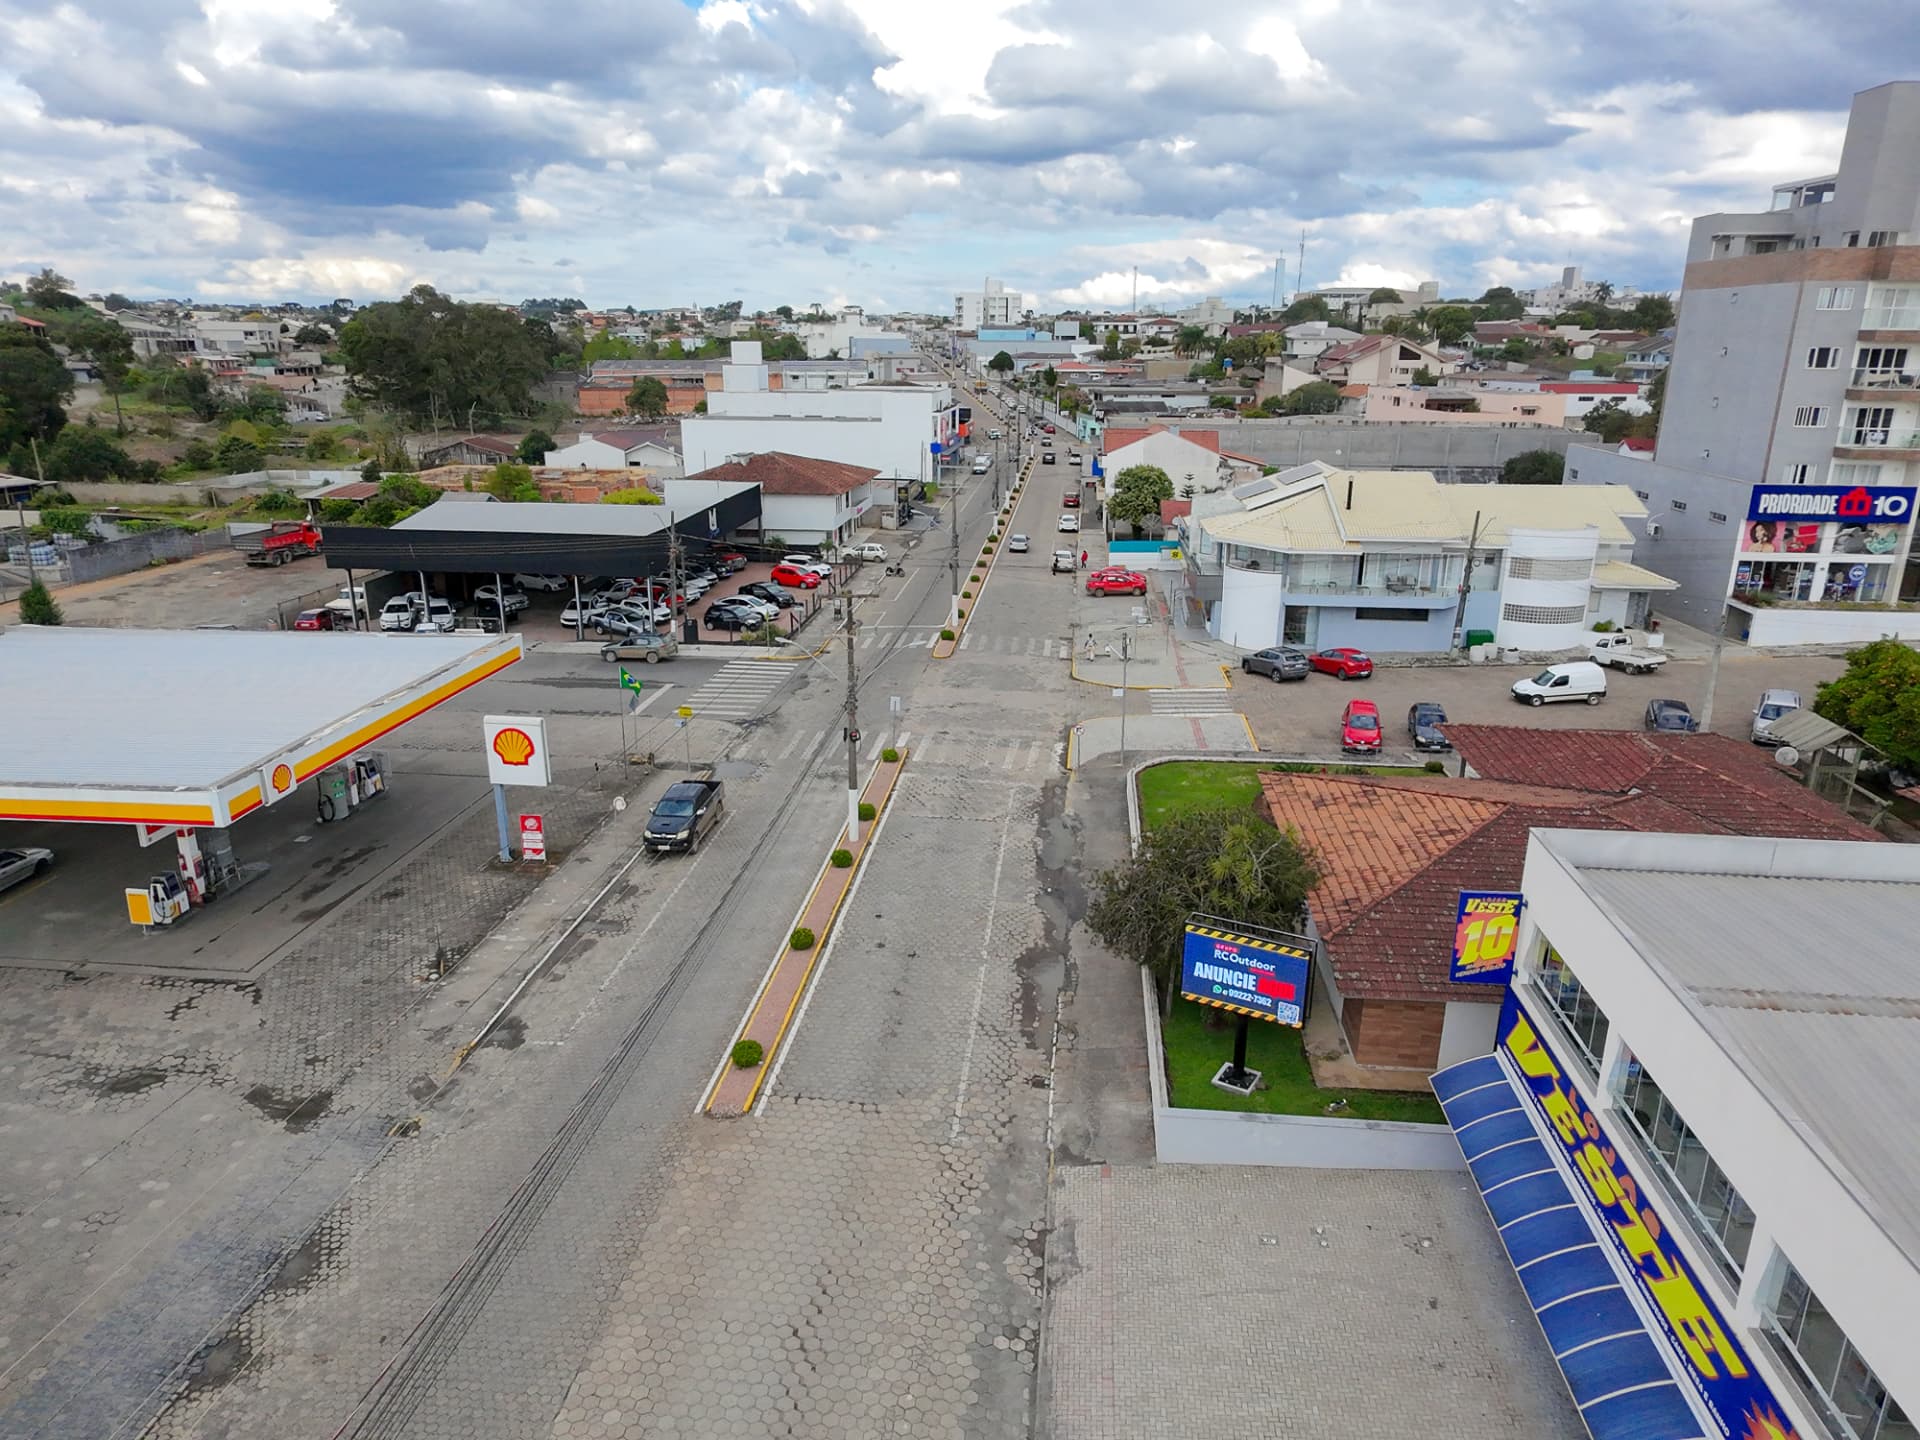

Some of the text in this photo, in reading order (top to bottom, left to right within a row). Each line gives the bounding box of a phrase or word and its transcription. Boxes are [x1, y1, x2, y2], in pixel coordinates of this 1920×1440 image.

[1758, 493, 1908, 517] PRIORIDADE 10
[1465, 899, 1519, 913] VESTE
[1458, 915, 1516, 966] 10
[1213, 949, 1276, 972] RCOutdoor
[1194, 962, 1257, 991] ANUNCIE
[1505, 1010, 1748, 1379] VESTE
